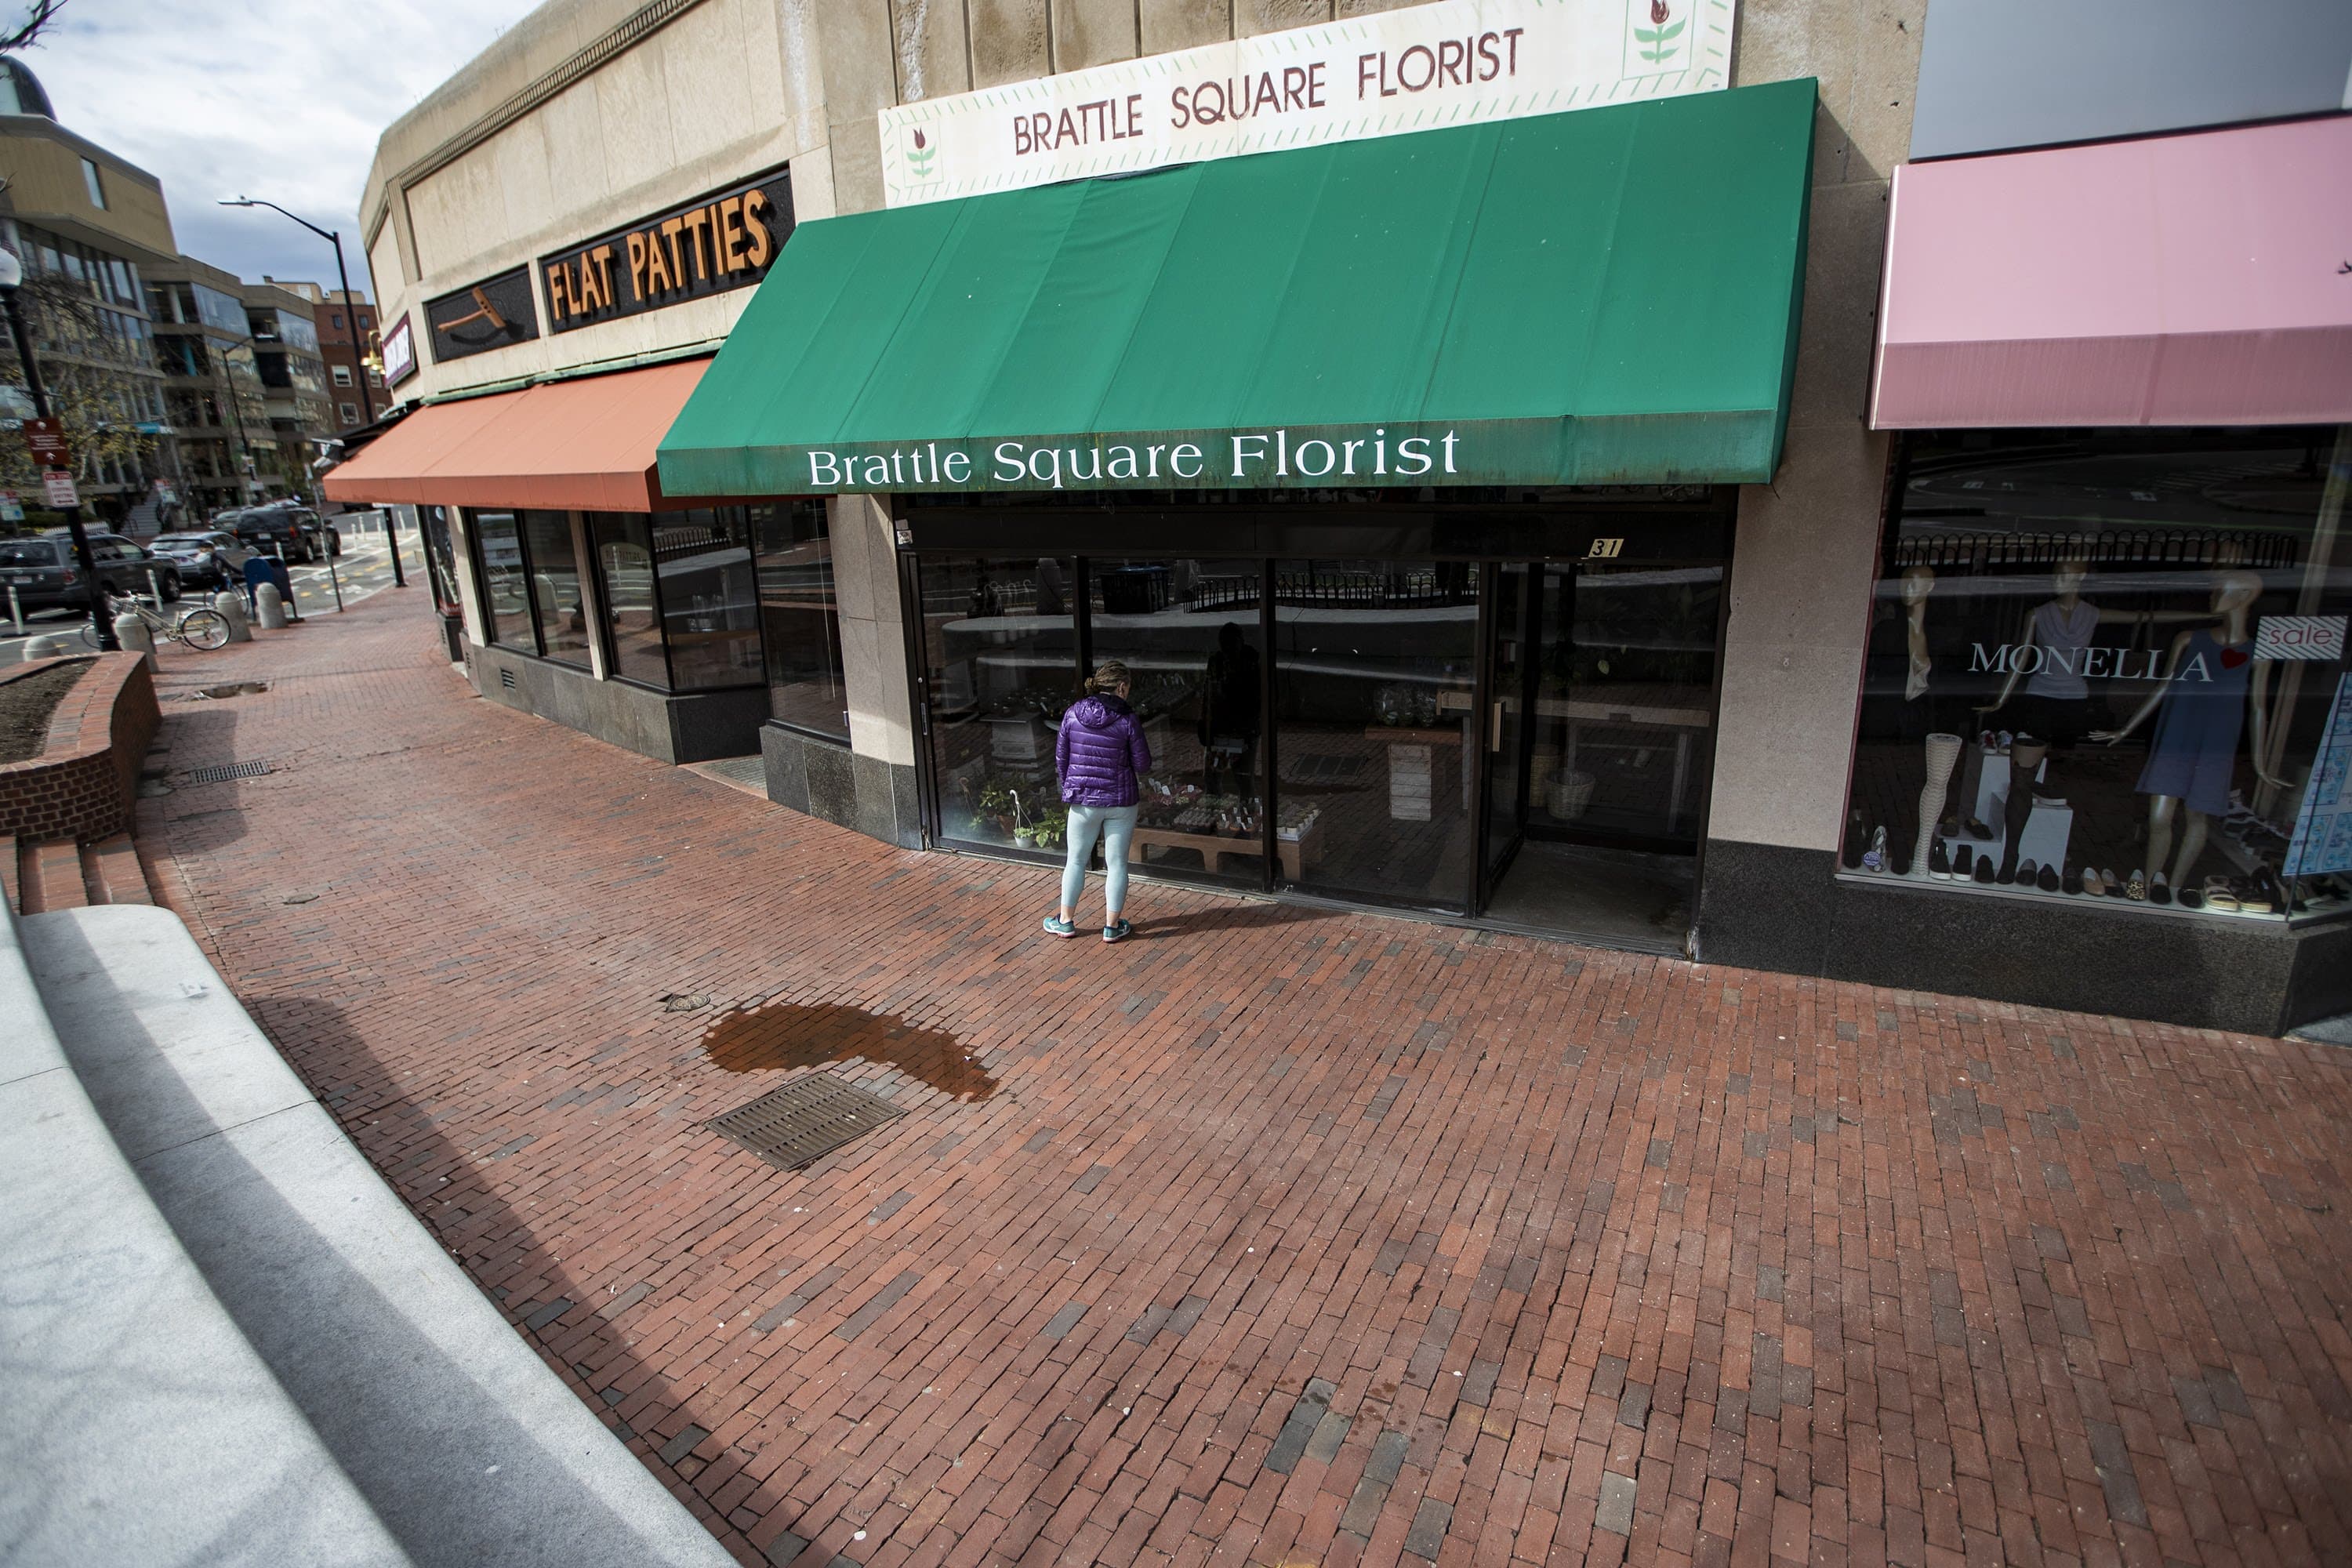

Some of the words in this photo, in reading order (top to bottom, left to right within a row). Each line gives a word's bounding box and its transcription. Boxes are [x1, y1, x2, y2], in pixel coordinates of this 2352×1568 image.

[1014, 93, 1144, 156] BRATTLE
[1171, 61, 1327, 129] SQUARE
[1357, 27, 1525, 102] FLORIST
[547, 243, 613, 321] FLAT
[626, 188, 772, 302] PATTIES
[807, 442, 972, 486] Brattle
[993, 441, 1203, 489] Square
[1230, 428, 1460, 477] Florist
[1592, 539, 1618, 556] 31
[2268, 625, 2334, 647] sale
[1967, 642, 2215, 683] MONELLA
